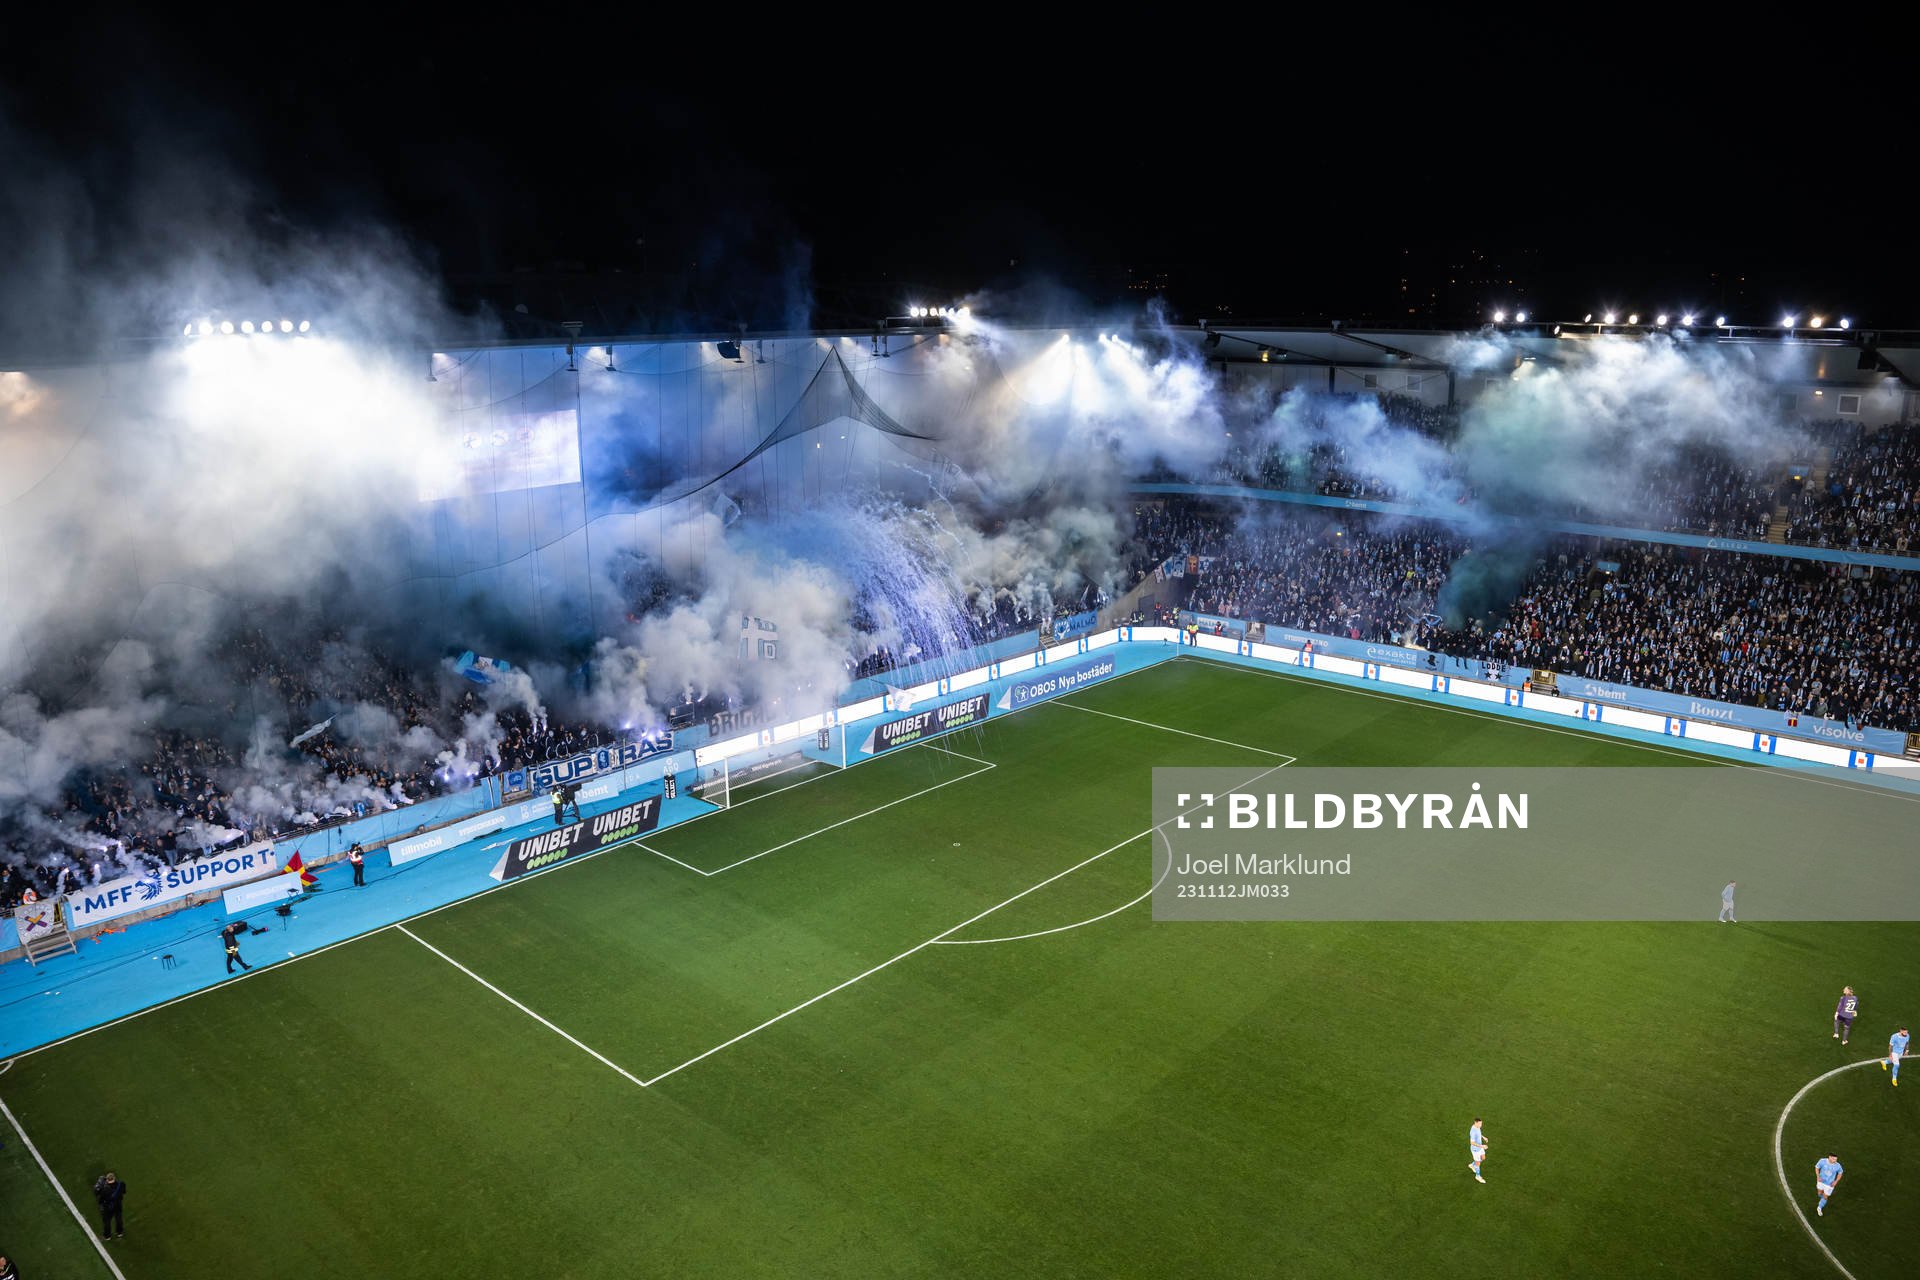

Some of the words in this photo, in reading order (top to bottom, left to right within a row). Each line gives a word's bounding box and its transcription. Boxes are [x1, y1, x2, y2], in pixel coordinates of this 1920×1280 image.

[1030, 680, 1056, 698] OBOS
[1058, 675, 1076, 691] Nya
[1077, 663, 1113, 683] bostäder
[1597, 685, 1627, 701] bemt
[882, 712, 931, 740] UNIBET
[938, 696, 983, 722] UNIBET
[1690, 701, 1735, 721] Boozt
[1813, 724, 1865, 742] visolve
[581, 784, 609, 800] bemt
[518, 822, 584, 861] UNIBET
[592, 799, 655, 836] UNIBET
[401, 836, 442, 856] tillmobil
[84, 885, 133, 914] MFF
[166, 850, 270, 889] SUPPORT
